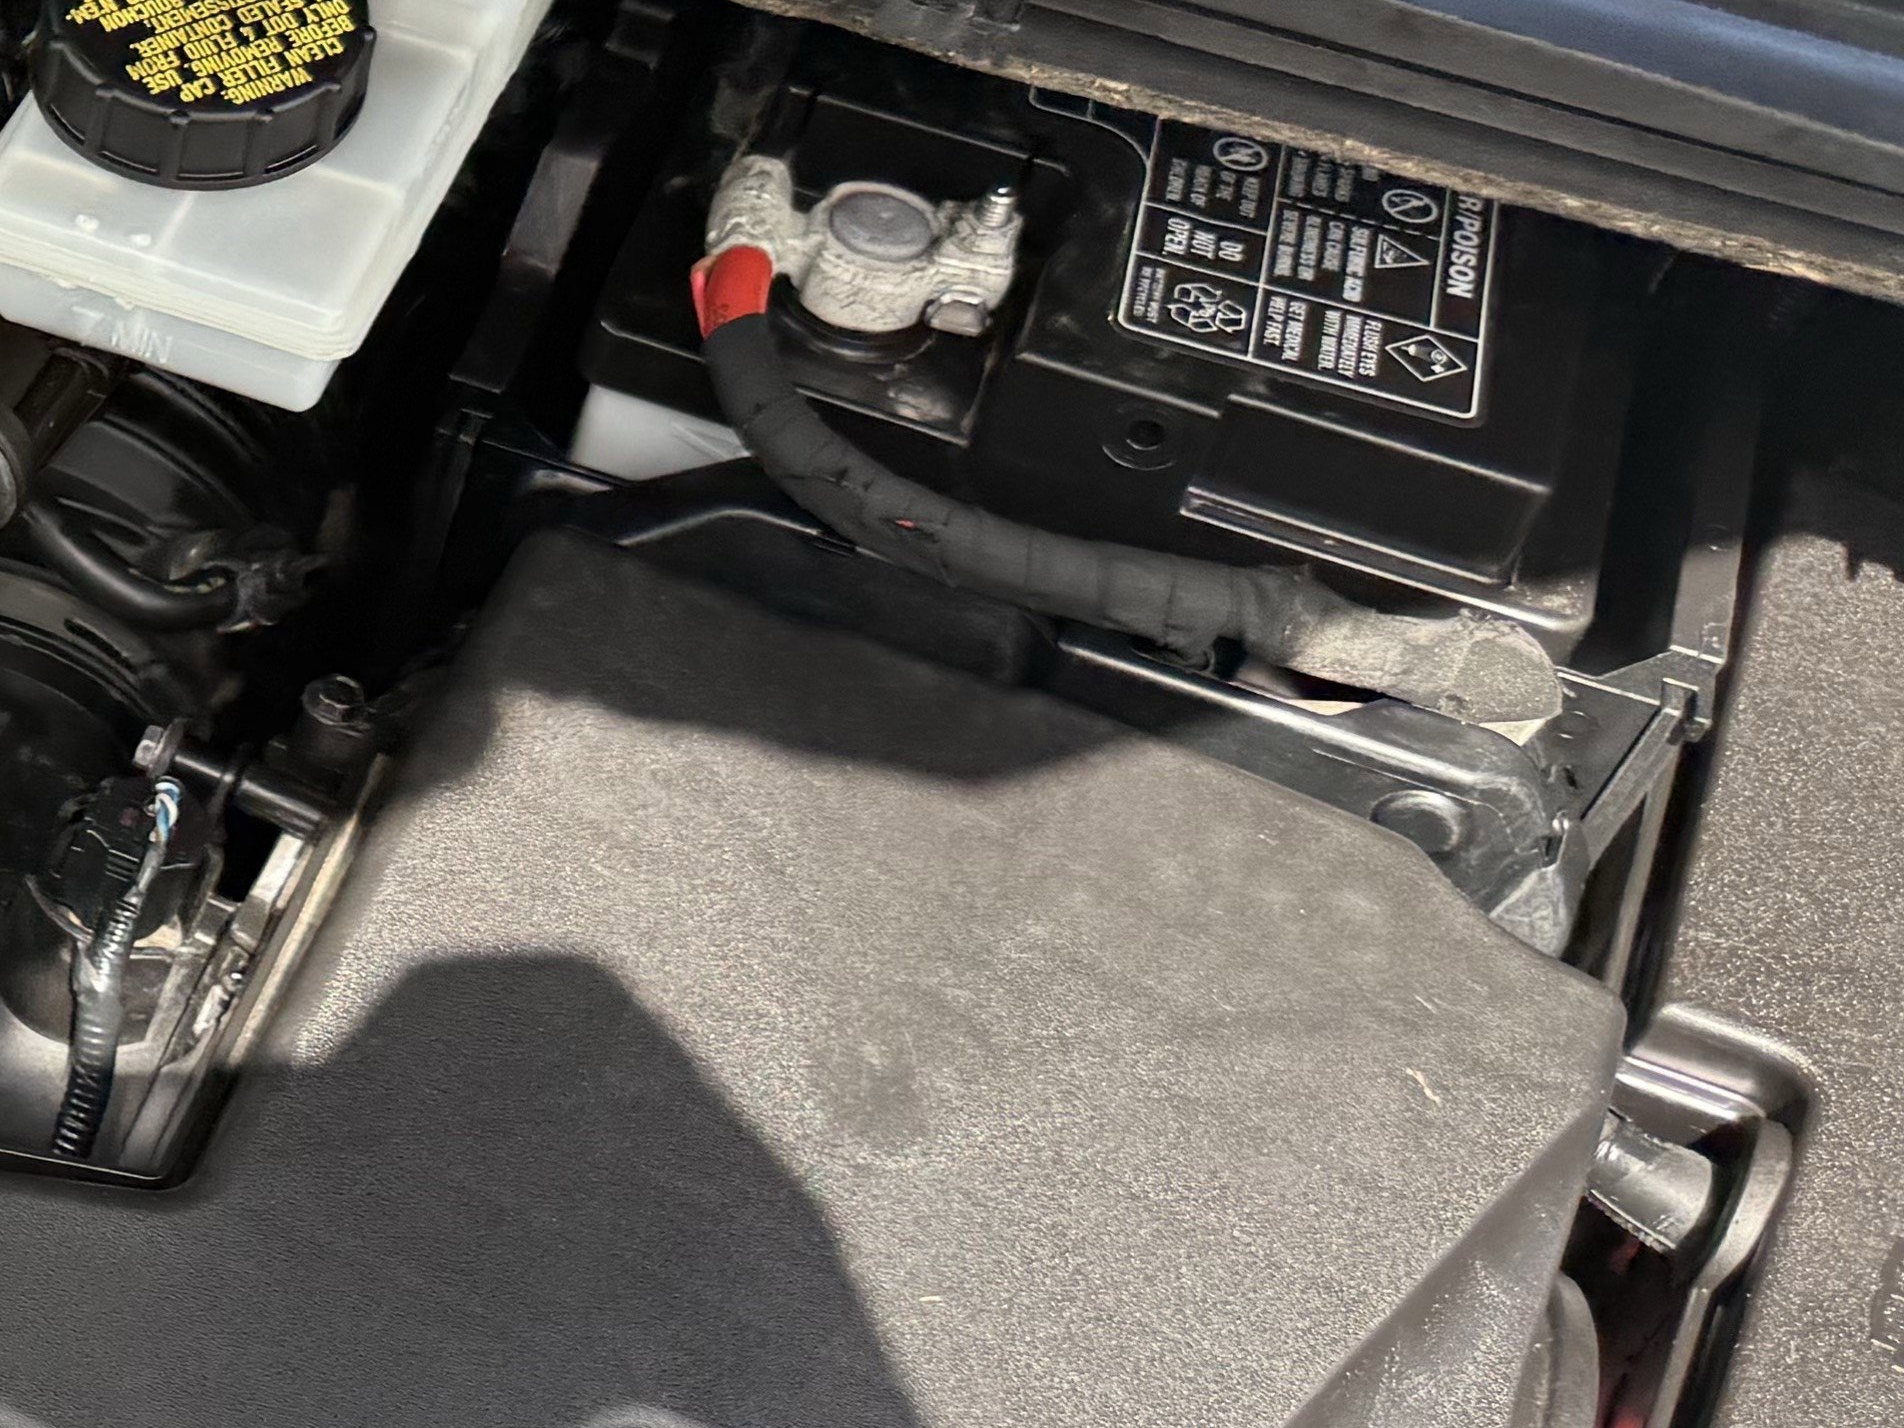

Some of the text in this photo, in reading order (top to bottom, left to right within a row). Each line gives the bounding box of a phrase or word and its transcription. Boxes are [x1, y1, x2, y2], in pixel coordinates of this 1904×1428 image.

[129, 14, 233, 58] CONTAINER.
[239, 26, 255, 41] 4
[262, 12, 299, 36] DOT
[142, 15, 355, 95] BEFORE REMOVING. USE
[183, 32, 237, 60] FLUID
[125, 51, 181, 80] FROM
[180, 37, 344, 102] CLEAN FILLER CAP
[220, 67, 312, 105] WARNING:
[1162, 217, 1190, 255] OPEN.
[1190, 229, 1216, 260] NOT
[1218, 241, 1244, 262] DO
[1267, 295, 1287, 322] HELP
[1323, 310, 1342, 336] WITH
[1281, 301, 1308, 362] GET MEDICAL
[1338, 314, 1364, 379] IMMEDIATELY
[1358, 319, 1382, 378] FLUSH EYES
